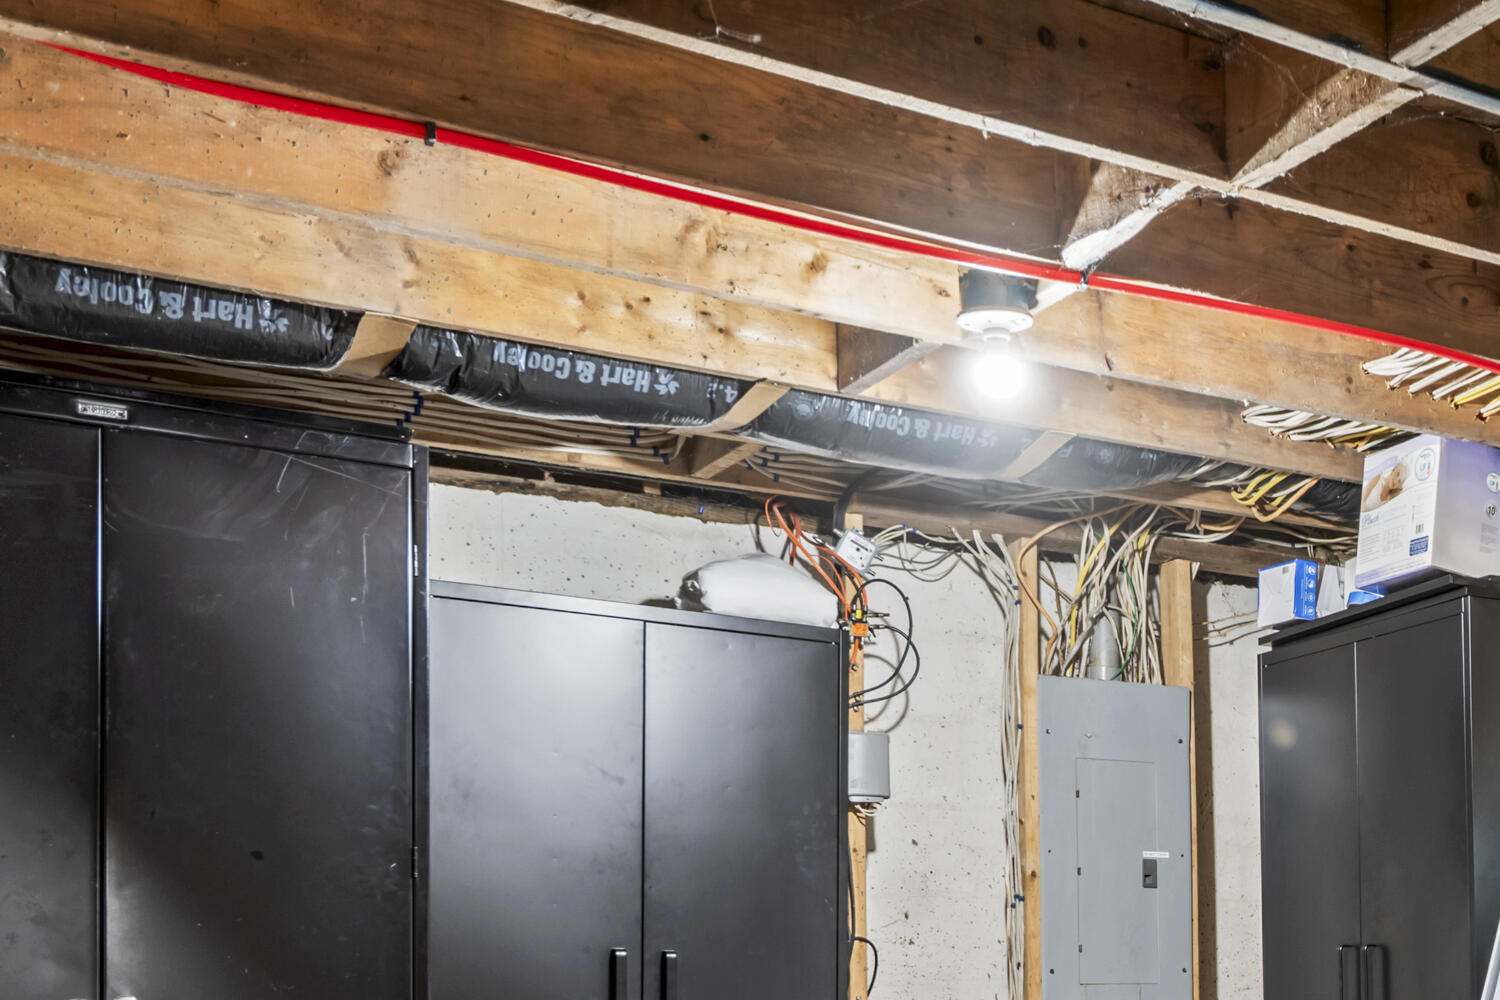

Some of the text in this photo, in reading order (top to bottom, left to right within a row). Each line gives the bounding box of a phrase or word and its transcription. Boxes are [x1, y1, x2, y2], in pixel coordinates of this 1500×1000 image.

[55, 267, 254, 330] Hart & Cooley
[492, 340, 651, 393] Hart & Cooley
[848, 400, 976, 447] Hart & Cooley
